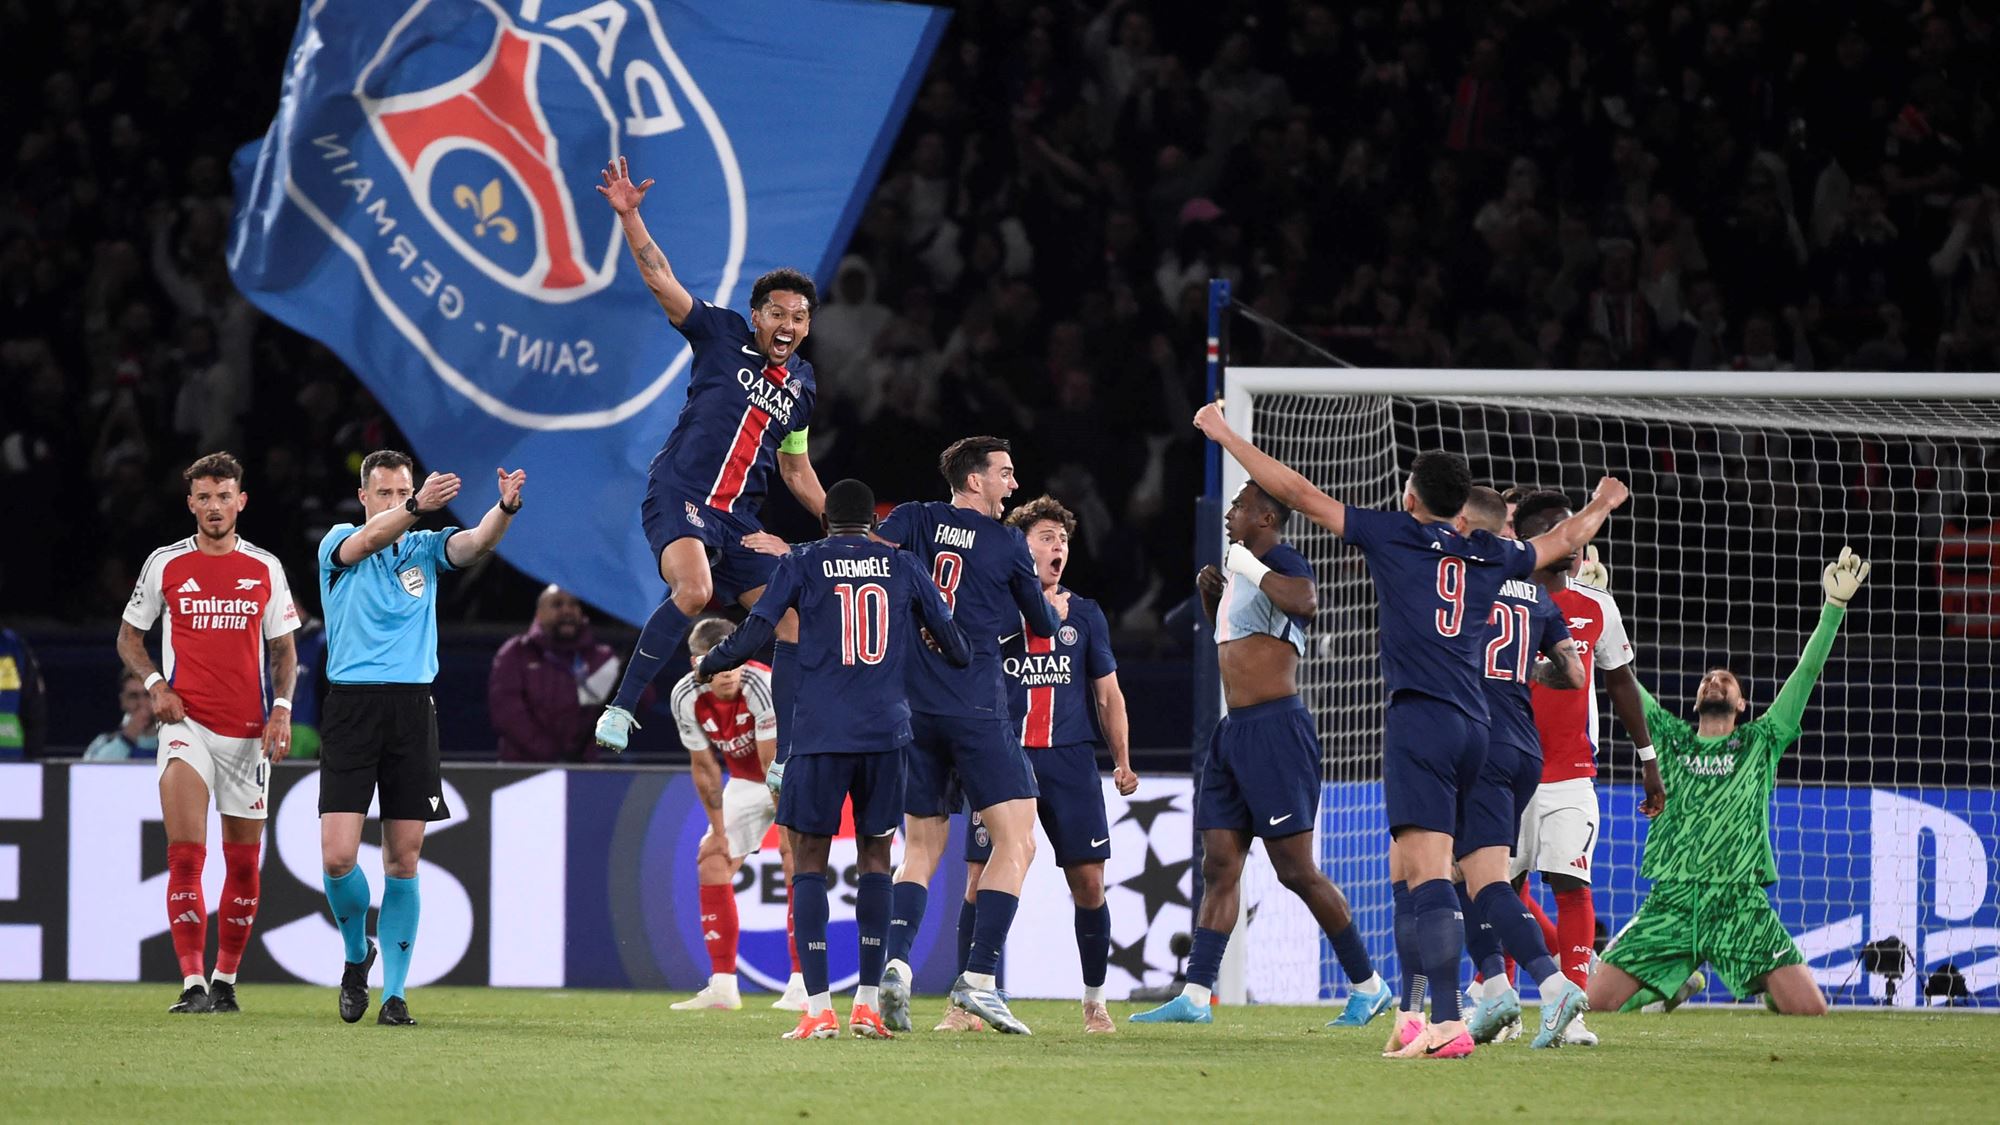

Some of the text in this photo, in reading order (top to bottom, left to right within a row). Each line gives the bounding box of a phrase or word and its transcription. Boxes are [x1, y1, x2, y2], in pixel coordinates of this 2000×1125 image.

[737, 367, 794, 416] QATAR
[747, 392, 791, 426] AIRWAYS
[934, 523, 976, 550] FABIAN
[932, 551, 963, 620] 8
[1435, 556, 1466, 638] 9
[179, 596, 259, 615] Emirates
[192, 615, 248, 629] FLY BETTER
[834, 583, 889, 666] 10
[1485, 600, 1531, 684] 21
[1003, 656, 1071, 678] QATAR
[1021, 673, 1071, 685] AIRWAYS
[1676, 754, 1735, 768] QATAR
[1583, 821, 1595, 852] 7
[170, 892, 198, 902] AFC
[233, 896, 258, 907] AFC
[1572, 945, 1592, 956] AFC
